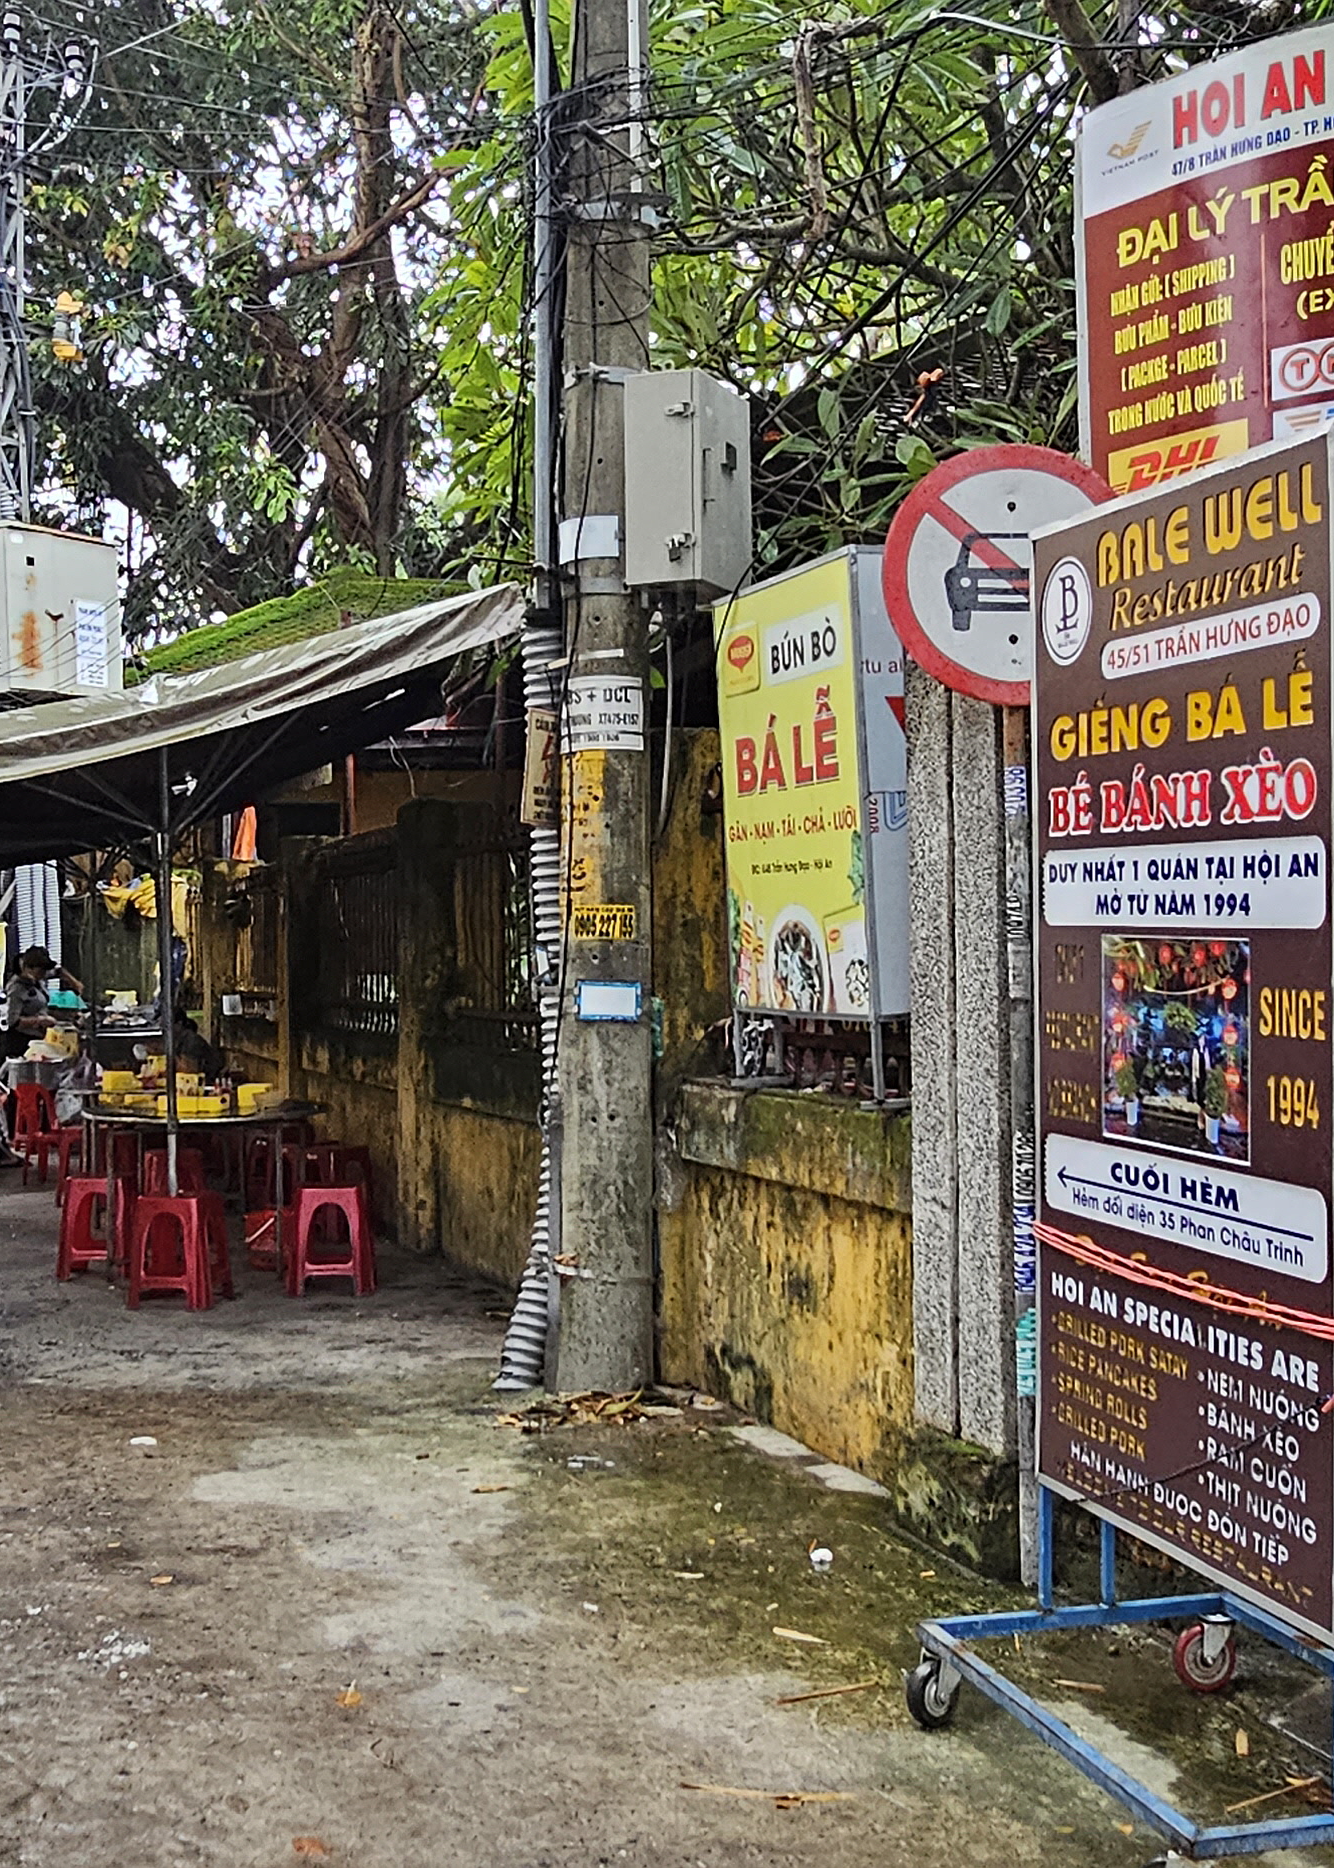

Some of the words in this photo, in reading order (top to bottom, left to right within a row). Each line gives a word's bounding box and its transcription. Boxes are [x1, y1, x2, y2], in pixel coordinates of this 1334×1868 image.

[1172, 72, 1246, 150] HOI
[1260, 49, 1326, 121] AN
[1116, 212, 1178, 269] ĐẠI
[1188, 186, 1236, 243] LÝ
[1095, 504, 1190, 588] BALE
[1202, 462, 1323, 556] WELL
[1109, 541, 1306, 632] Restaurant
[770, 630, 805, 676] BÚN
[811, 616, 837, 663] BÒ
[1106, 638, 1151, 671] 45/51
[1205, 614, 1263, 651] HƯNG
[1266, 602, 1312, 638] ĐẠO
[1185, 671, 1247, 743] BÁ
[735, 712, 789, 798] BÁ
[792, 684, 841, 789] LỄ
[1048, 769, 1093, 837] BÉ
[1100, 763, 1212, 833] BÁNH
[1220, 746, 1318, 825] XÈO
[1131, 859, 1140, 882] 1
[1205, 855, 1235, 886] TẠI
[1287, 851, 1320, 878] AN
[1203, 892, 1252, 917] 1994
[1258, 985, 1327, 1042] SINCE
[1265, 1074, 1321, 1130] 1994
[1110, 1162, 1170, 1195] CUỐI
[1159, 1210, 1176, 1232] 35
[1179, 1215, 1216, 1243] Phan
[1220, 1226, 1261, 1256] Châu
[1051, 1271, 1085, 1307] HOI
[1089, 1285, 1119, 1320] AN
[1270, 1349, 1321, 1394] ARE
[1109, 1330, 1146, 1366] PORK
[1058, 1371, 1103, 1411] SPRING
[1106, 1392, 1148, 1431] ROLLS
[1109, 1426, 1147, 1464] PORK
